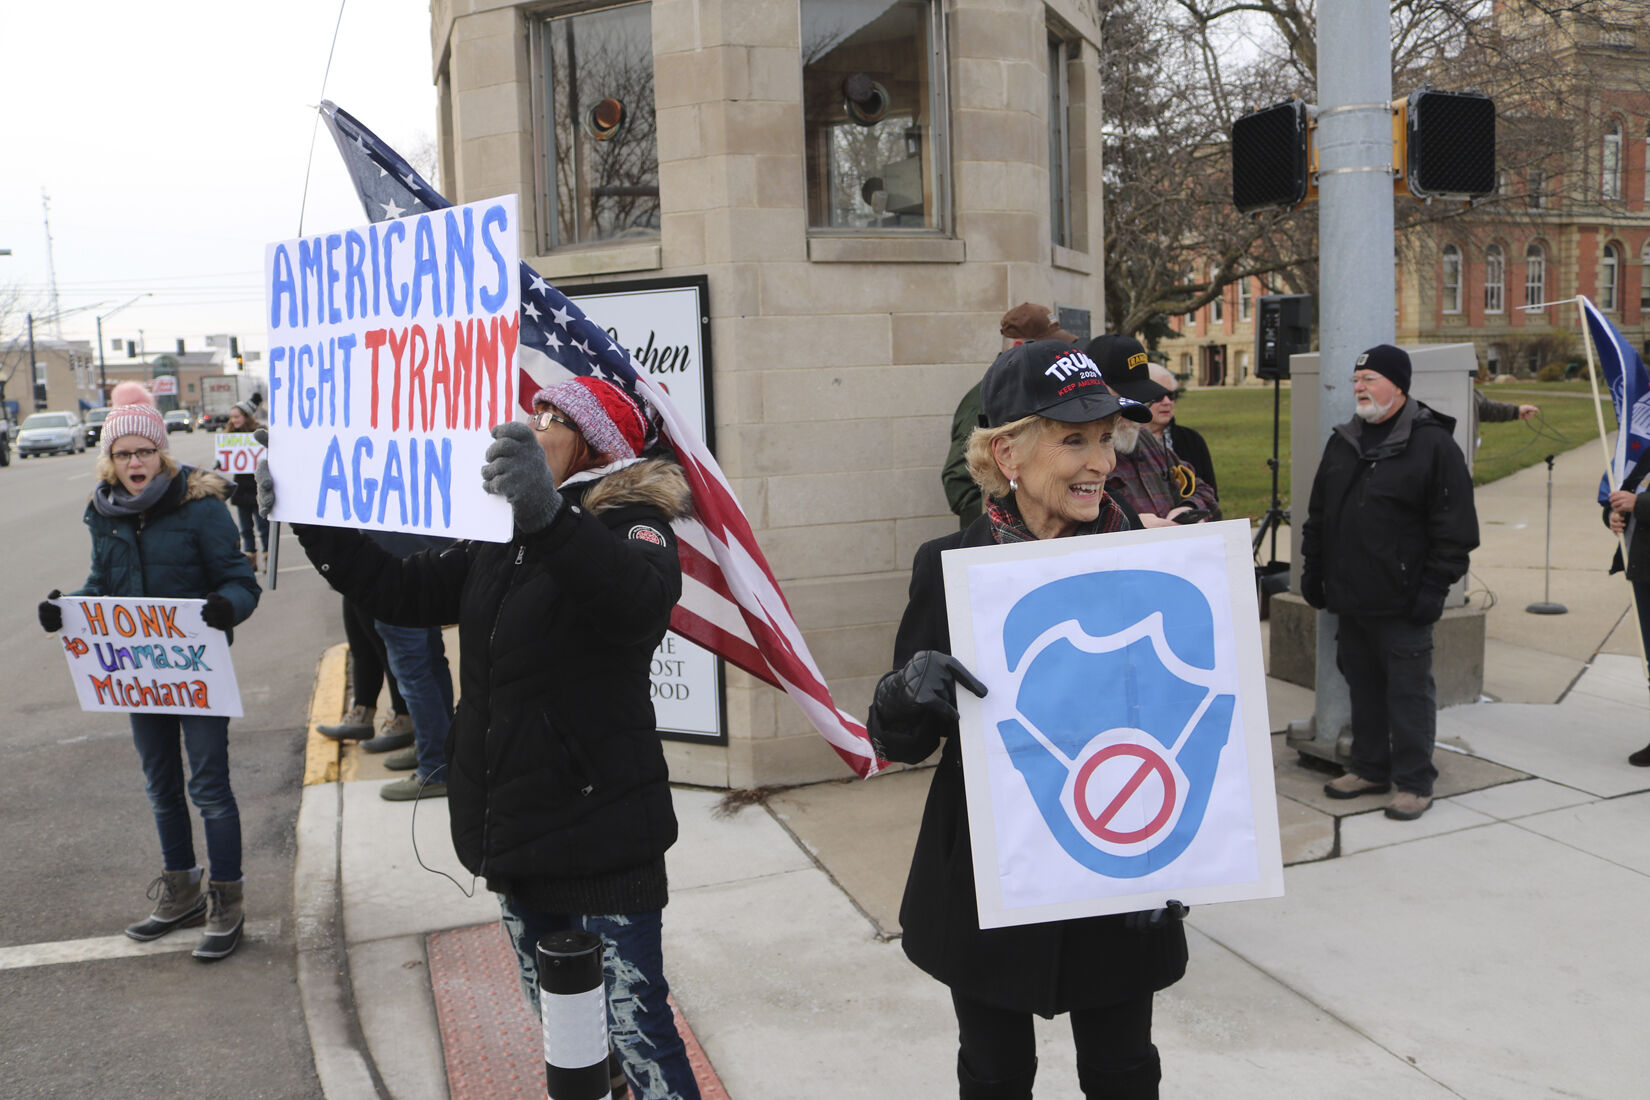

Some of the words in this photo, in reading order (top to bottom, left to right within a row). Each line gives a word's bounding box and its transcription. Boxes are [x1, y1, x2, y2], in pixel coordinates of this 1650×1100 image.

[271, 204, 508, 329] AMERICANS
[270, 333, 357, 429] FIGHT
[365, 310, 519, 433] TYRANNY
[1058, 383, 1076, 396] KEEP
[218, 447, 264, 472] JOY
[316, 434, 452, 529] AGAIN
[80, 601, 186, 638] HONK
[62, 636, 89, 659] to
[94, 642, 213, 672] Unmask
[88, 674, 211, 709] Michiana
